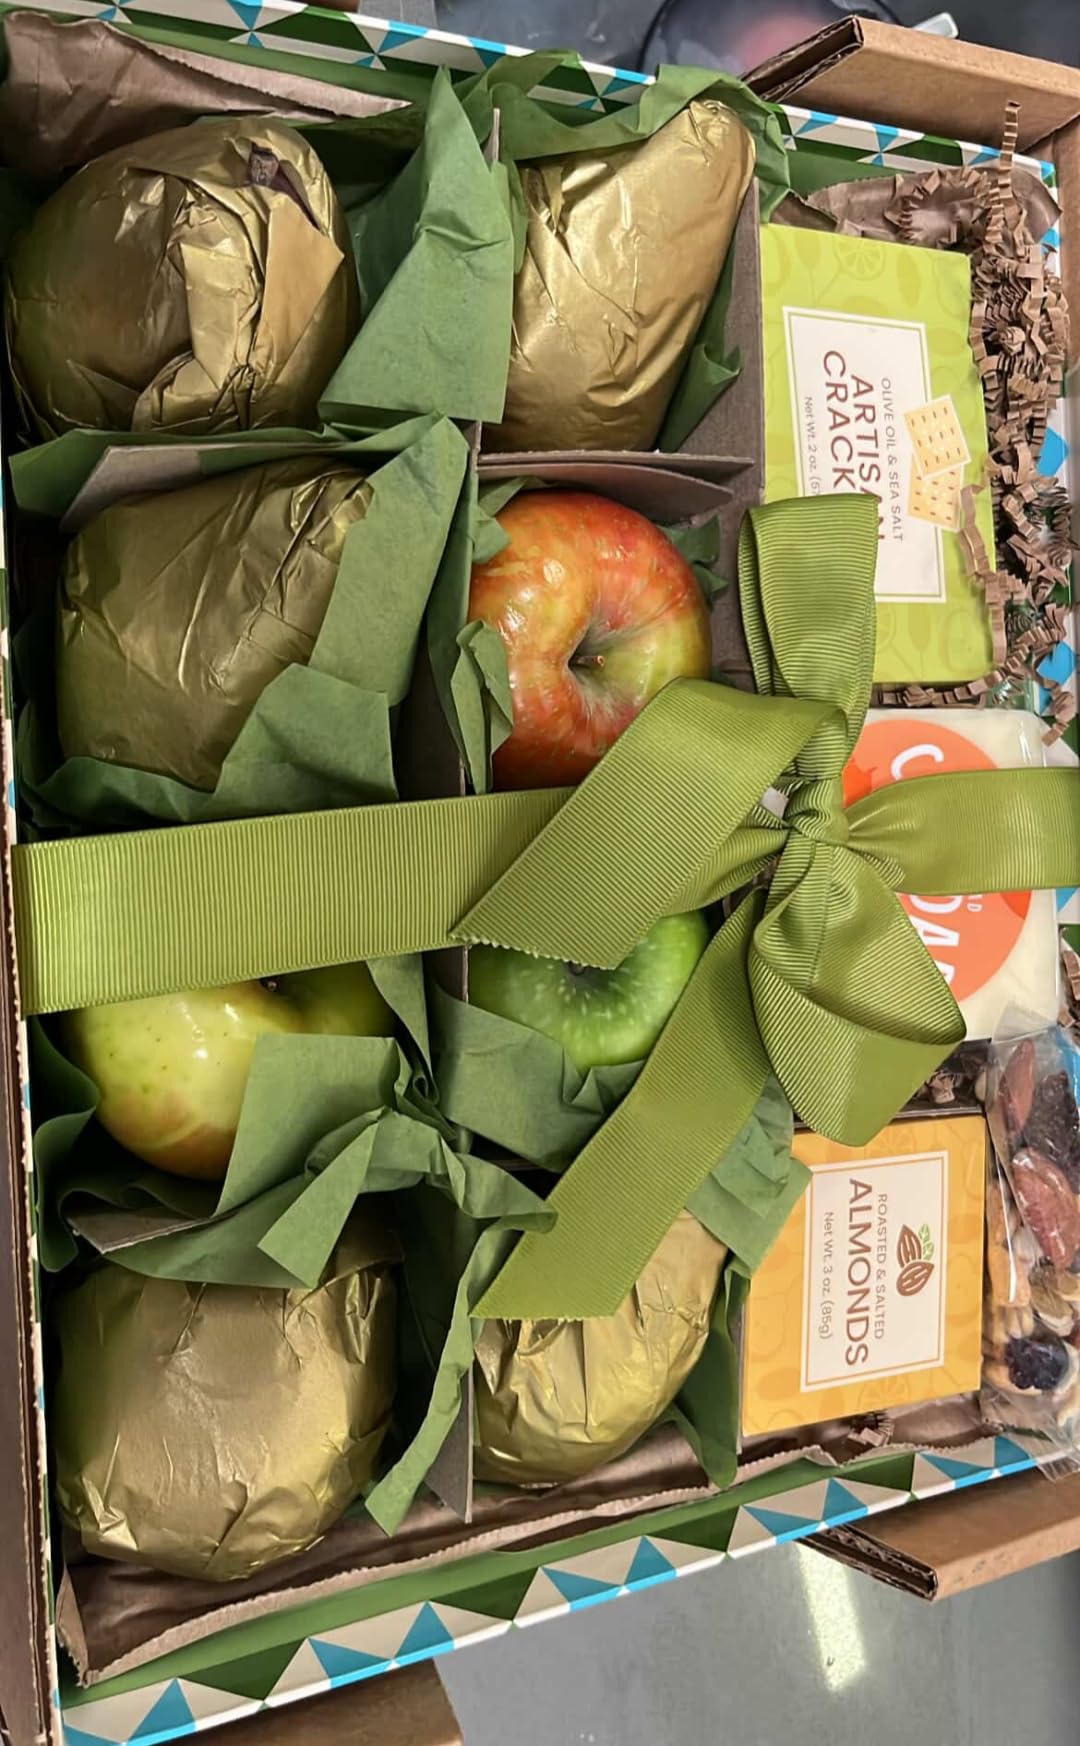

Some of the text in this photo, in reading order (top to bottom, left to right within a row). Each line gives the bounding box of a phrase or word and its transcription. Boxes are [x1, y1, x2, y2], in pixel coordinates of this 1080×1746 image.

[805, 396, 814, 421] Net
[808, 444, 818, 453] 2
[824, 350, 856, 489] CRACK
[851, 374, 885, 540] ARTIS
[881, 377, 904, 541] OLIVE OIL & SEA SALT
[824, 1212, 834, 1237] Net
[874, 1193, 888, 1340] ROASTED & SALTED
[823, 1265, 833, 1274] 3
[845, 1178, 873, 1366] ALMONDS
[818, 1301, 834, 1340] (85g)
